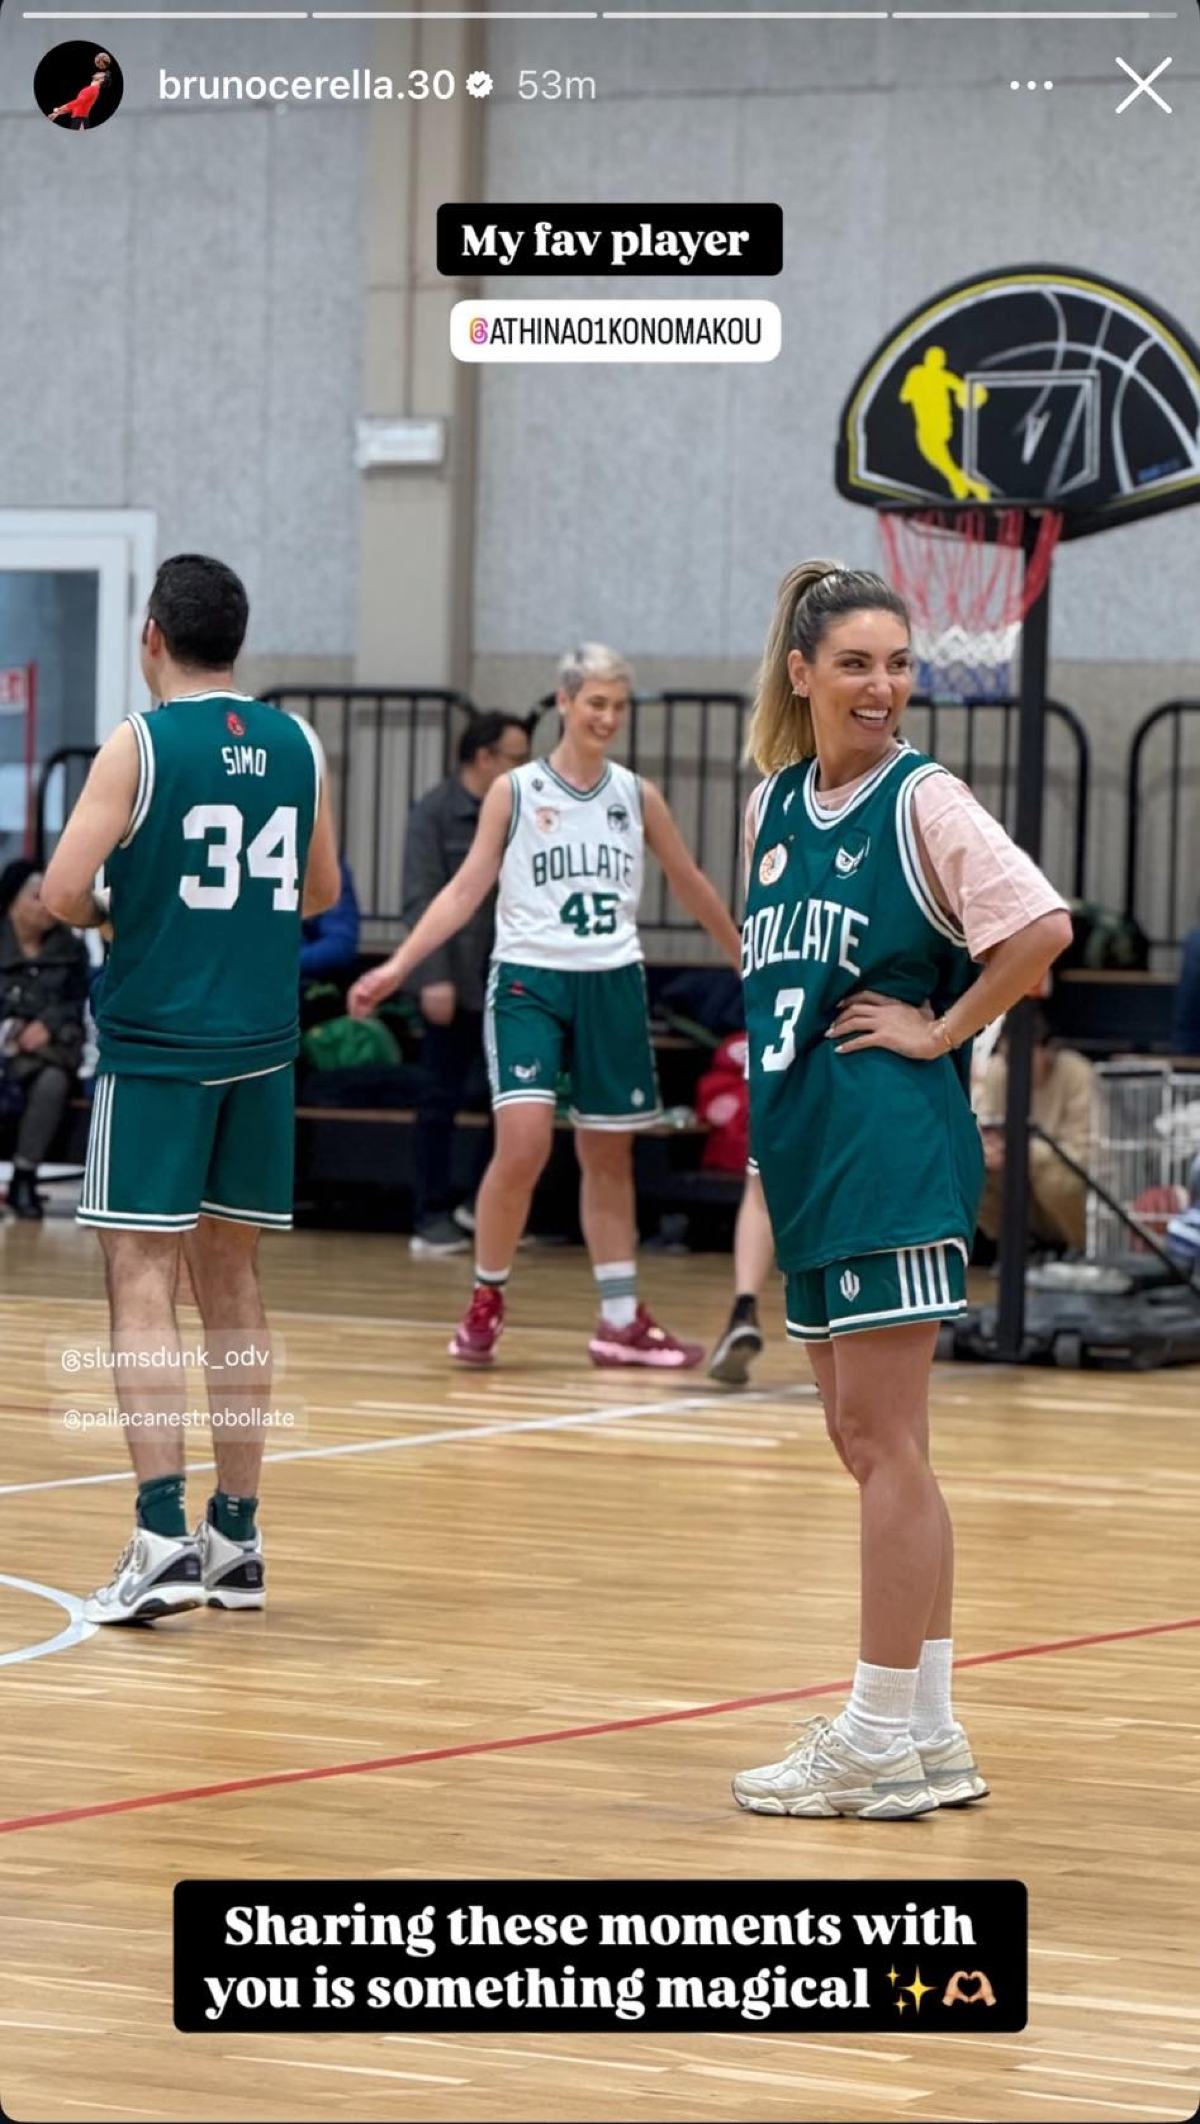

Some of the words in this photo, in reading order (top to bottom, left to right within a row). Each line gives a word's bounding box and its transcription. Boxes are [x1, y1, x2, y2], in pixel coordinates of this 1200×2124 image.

[221, 746, 267, 777] SIMO
[179, 804, 300, 912] 34
[532, 843, 634, 887] BOLLATE
[559, 892, 621, 937] 45
[740, 898, 869, 981] BOLLATE
[760, 987, 805, 1072] 3
